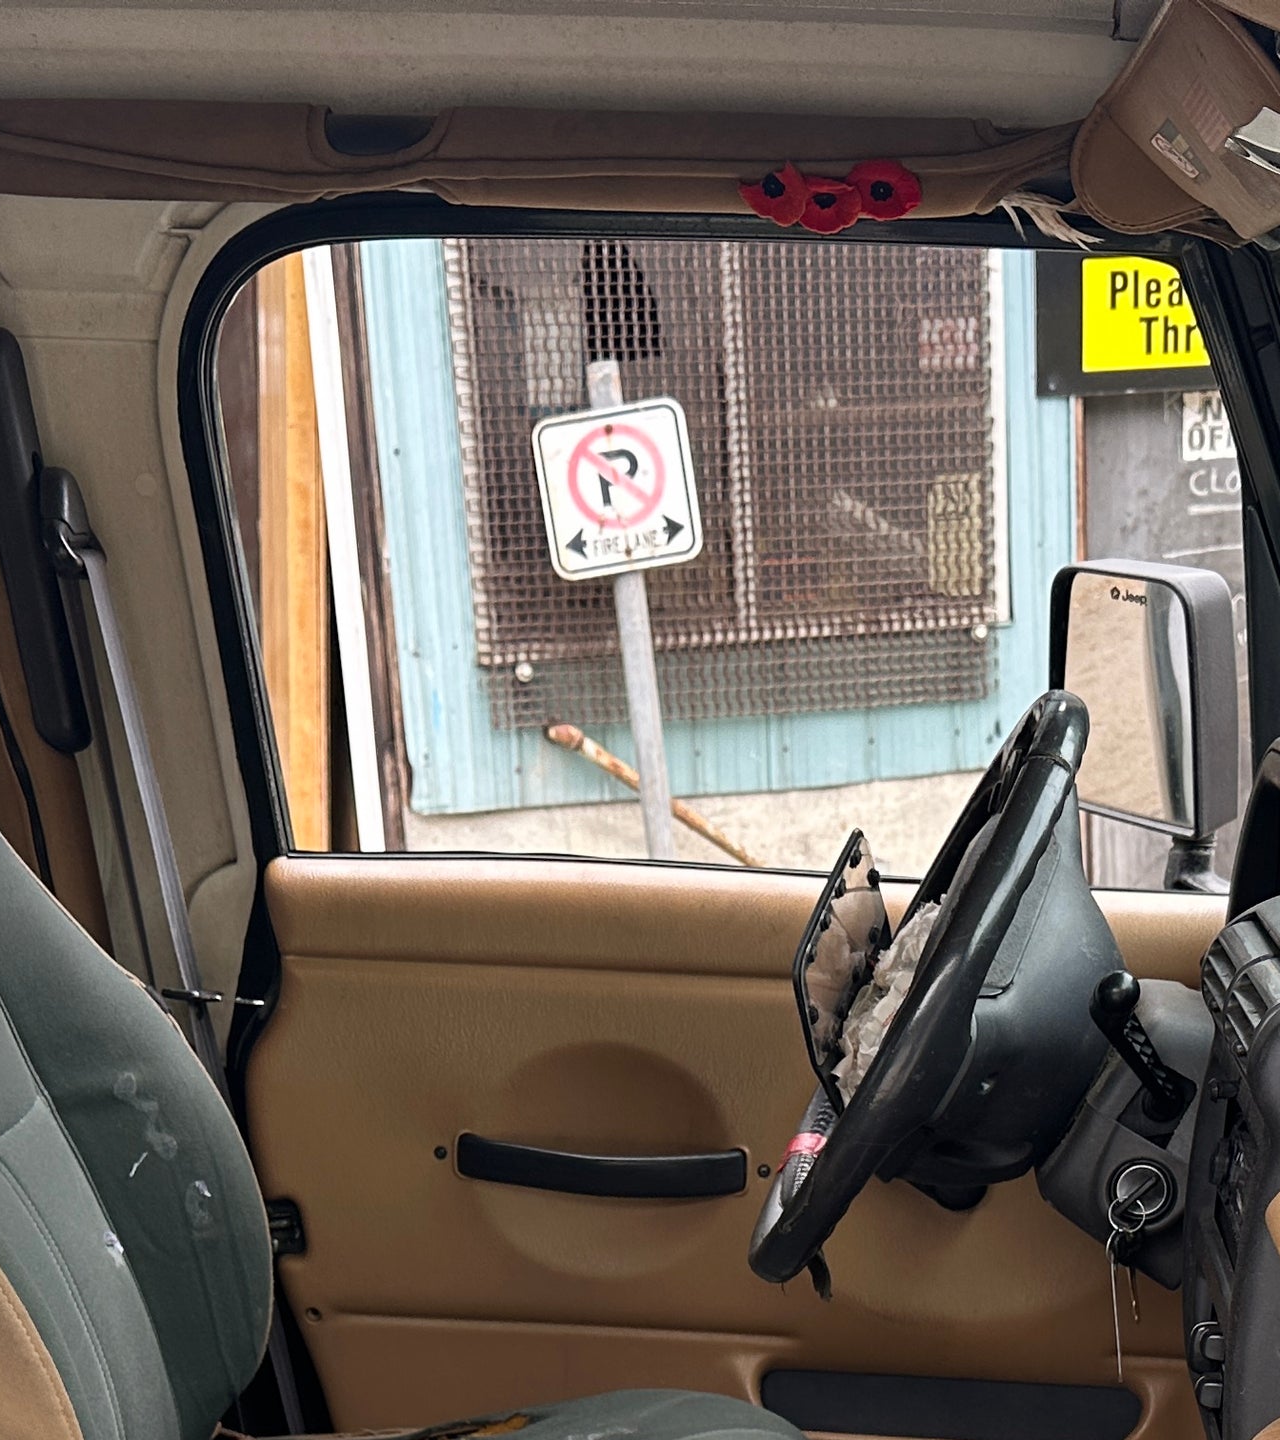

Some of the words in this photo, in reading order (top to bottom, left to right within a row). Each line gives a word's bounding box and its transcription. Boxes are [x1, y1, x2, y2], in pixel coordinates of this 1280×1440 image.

[1110, 269, 1184, 310] Plea
[1139, 315, 1203, 355] Thr
[1189, 468, 1242, 497] CLO
[1122, 589, 1148, 606] Jeep
